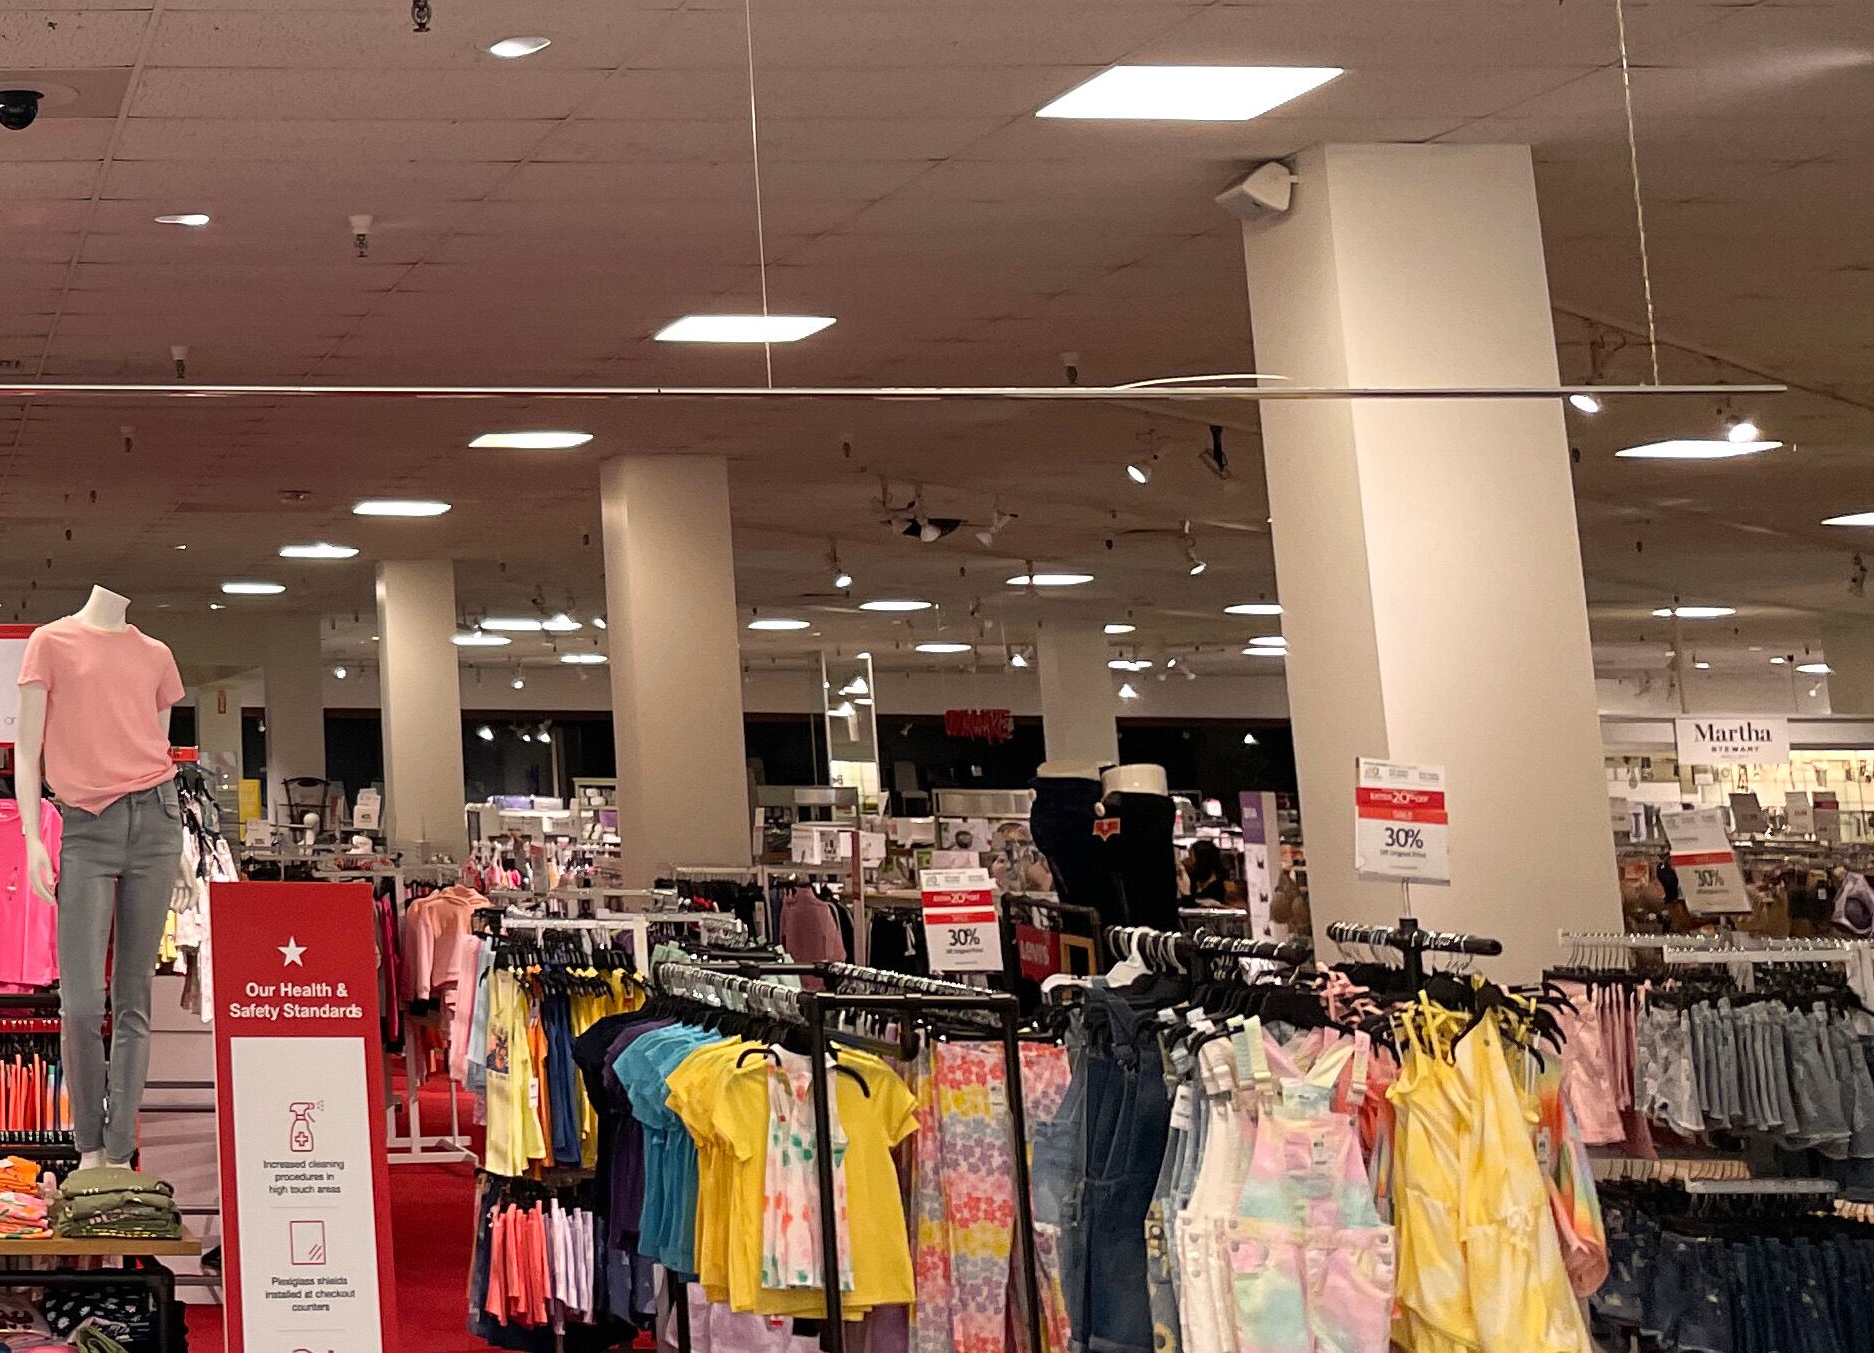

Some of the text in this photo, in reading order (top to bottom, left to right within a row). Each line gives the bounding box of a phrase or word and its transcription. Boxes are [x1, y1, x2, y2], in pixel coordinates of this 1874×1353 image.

[1695, 722, 1772, 742] Martha
[1384, 827, 1424, 849] 30%
[948, 928, 980, 946] 30%
[245, 982, 348, 997] Our Health &
[229, 1003, 363, 1020] Safety Standards
[263, 1160, 345, 1170] Increased cleaning
[275, 1173, 324, 1182] procedures
[269, 1186, 288, 1196] high
[271, 1277, 348, 1287] Plexiglass shields
[265, 1290, 302, 1298] installed
[315, 1290, 356, 1298] checkout
[291, 1303, 330, 1311] counters
